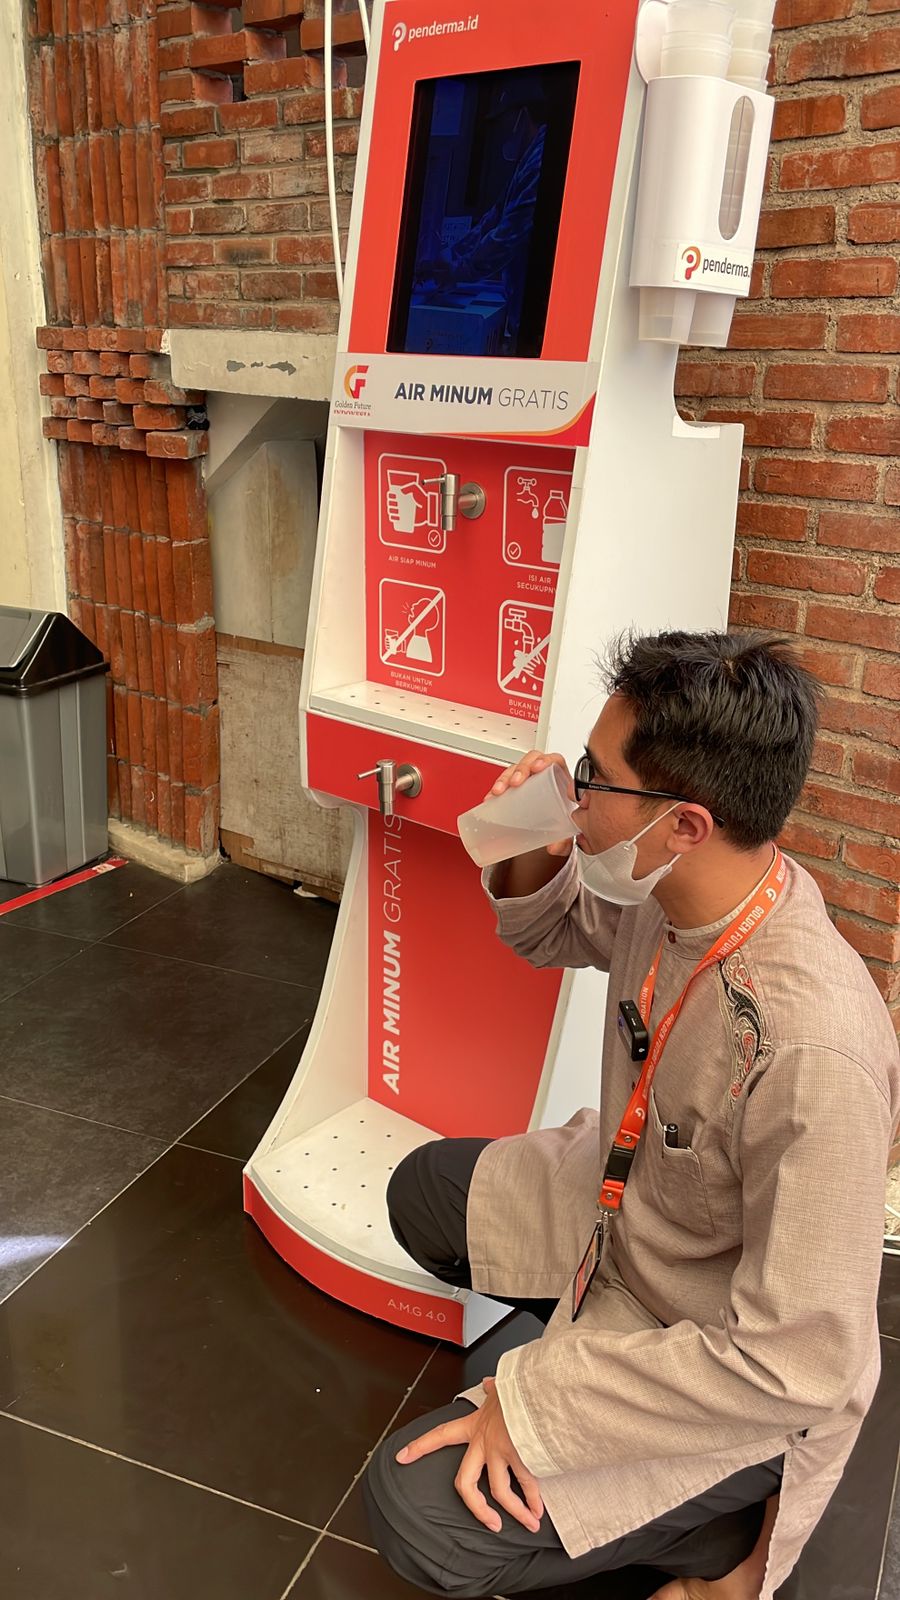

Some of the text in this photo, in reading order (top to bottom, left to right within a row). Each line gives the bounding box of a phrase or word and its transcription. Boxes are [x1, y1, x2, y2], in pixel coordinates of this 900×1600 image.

[408, 14, 479, 42] penderma.id
[394, 382, 569, 411] AIR MINUM GRATIS
[388, 554, 437, 569] AIR SIAP MINUM
[539, 576, 552, 584] AIR
[508, 699, 532, 710] BUKAN
[509, 707, 526, 718] CUCI
[717, 905, 765, 956] GOLDEN FUTURE
[382, 814, 402, 1096] AIR MINUM GRATIS
[425, 1310, 446, 1323] 4.0
